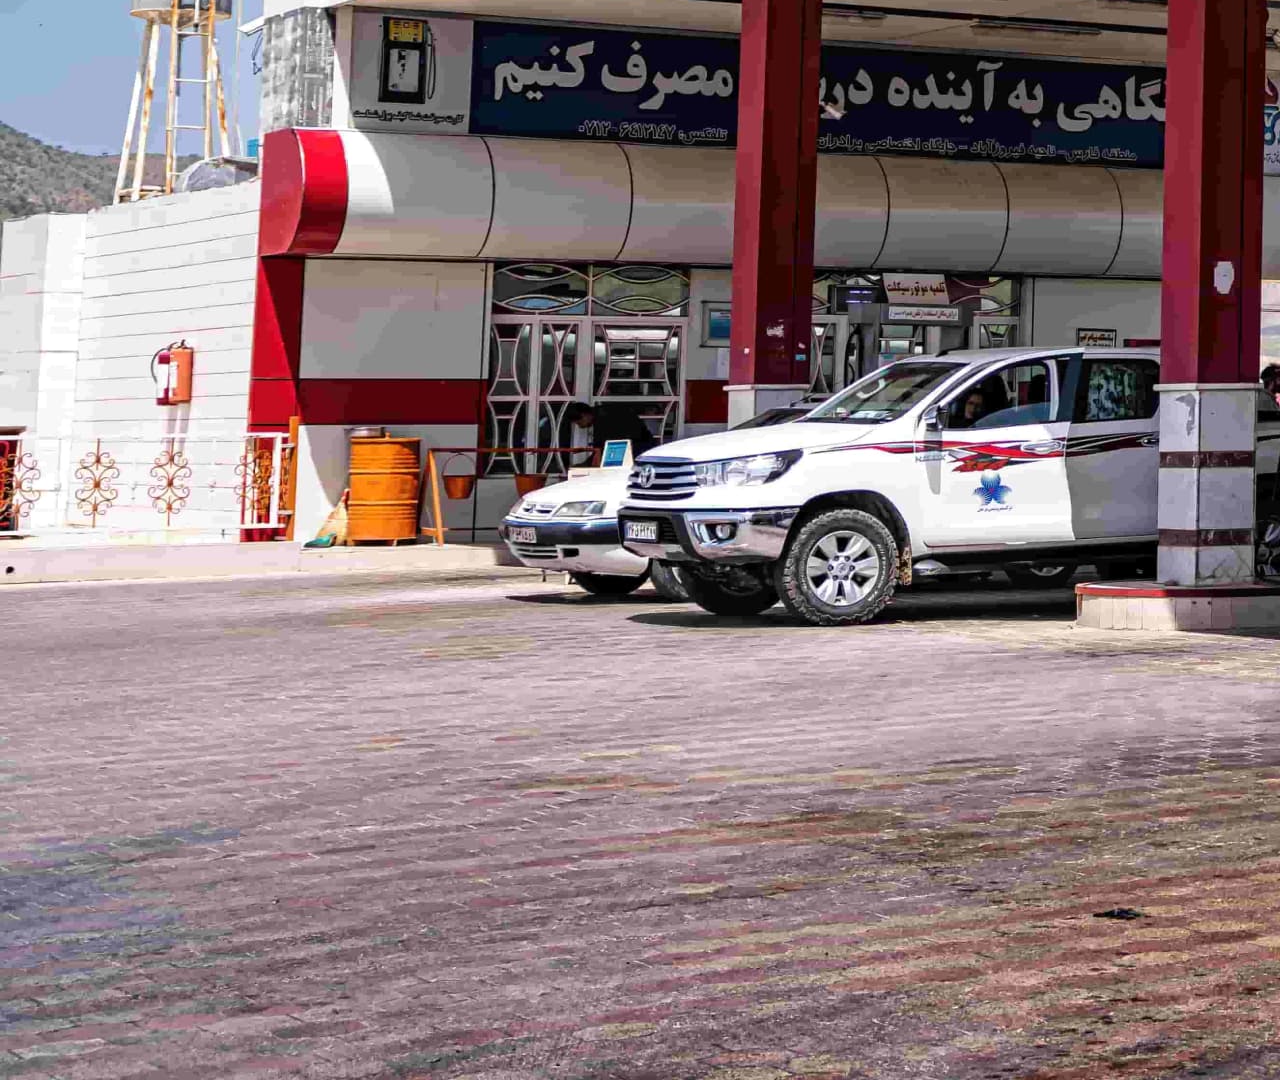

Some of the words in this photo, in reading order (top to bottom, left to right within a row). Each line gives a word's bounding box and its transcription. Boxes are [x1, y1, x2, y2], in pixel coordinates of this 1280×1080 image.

[494, 40, 595, 101] کنیم
[601, 41, 733, 110] مصرف
[887, 60, 1004, 124] آینده
[1007, 78, 1044, 128] به
[1057, 74, 1166, 132] گاهی
